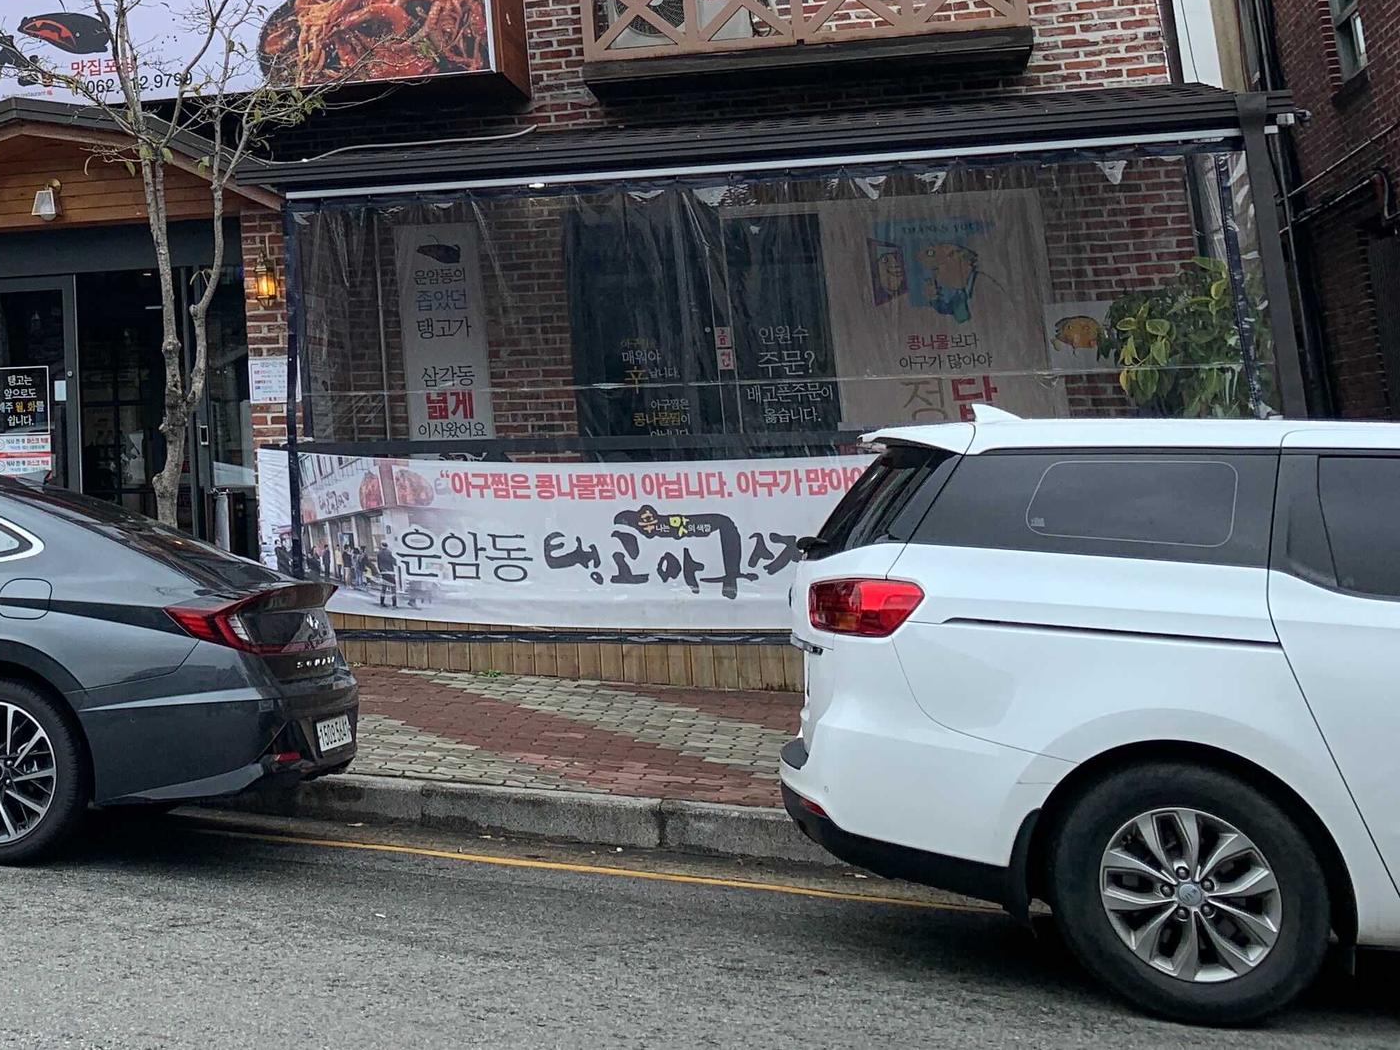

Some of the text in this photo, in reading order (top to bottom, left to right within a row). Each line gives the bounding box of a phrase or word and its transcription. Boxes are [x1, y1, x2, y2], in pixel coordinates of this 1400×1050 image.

[412, 267, 466, 286] 운암동의
[416, 289, 468, 311] 좁았던
[416, 316, 472, 340] 탱고가
[759, 325, 809, 345] 인원수
[906, 333, 979, 351] 콩나물보다
[621, 349, 662, 365] 매워야
[757, 350, 816, 378] 주문?
[899, 352, 993, 371] 아구가 많아야
[7, 375, 33, 386] 탱고는
[420, 365, 475, 387] 삼각동
[3, 388, 37, 400] 앞으로도
[746, 381, 833, 404] 배고픈주문이
[425, 389, 474, 420] 넓게
[7, 414, 34, 427] 쉽니다.
[633, 411, 691, 427] 콩나물찜이
[763, 406, 821, 424] 옳습니다.
[418, 421, 487, 438] 이사왔어요
[535, 472, 637, 500] 콩나물찜이
[640, 471, 733, 500] 아닙니다.
[736, 469, 802, 498] 아구가
[396, 528, 533, 583] 운암동
